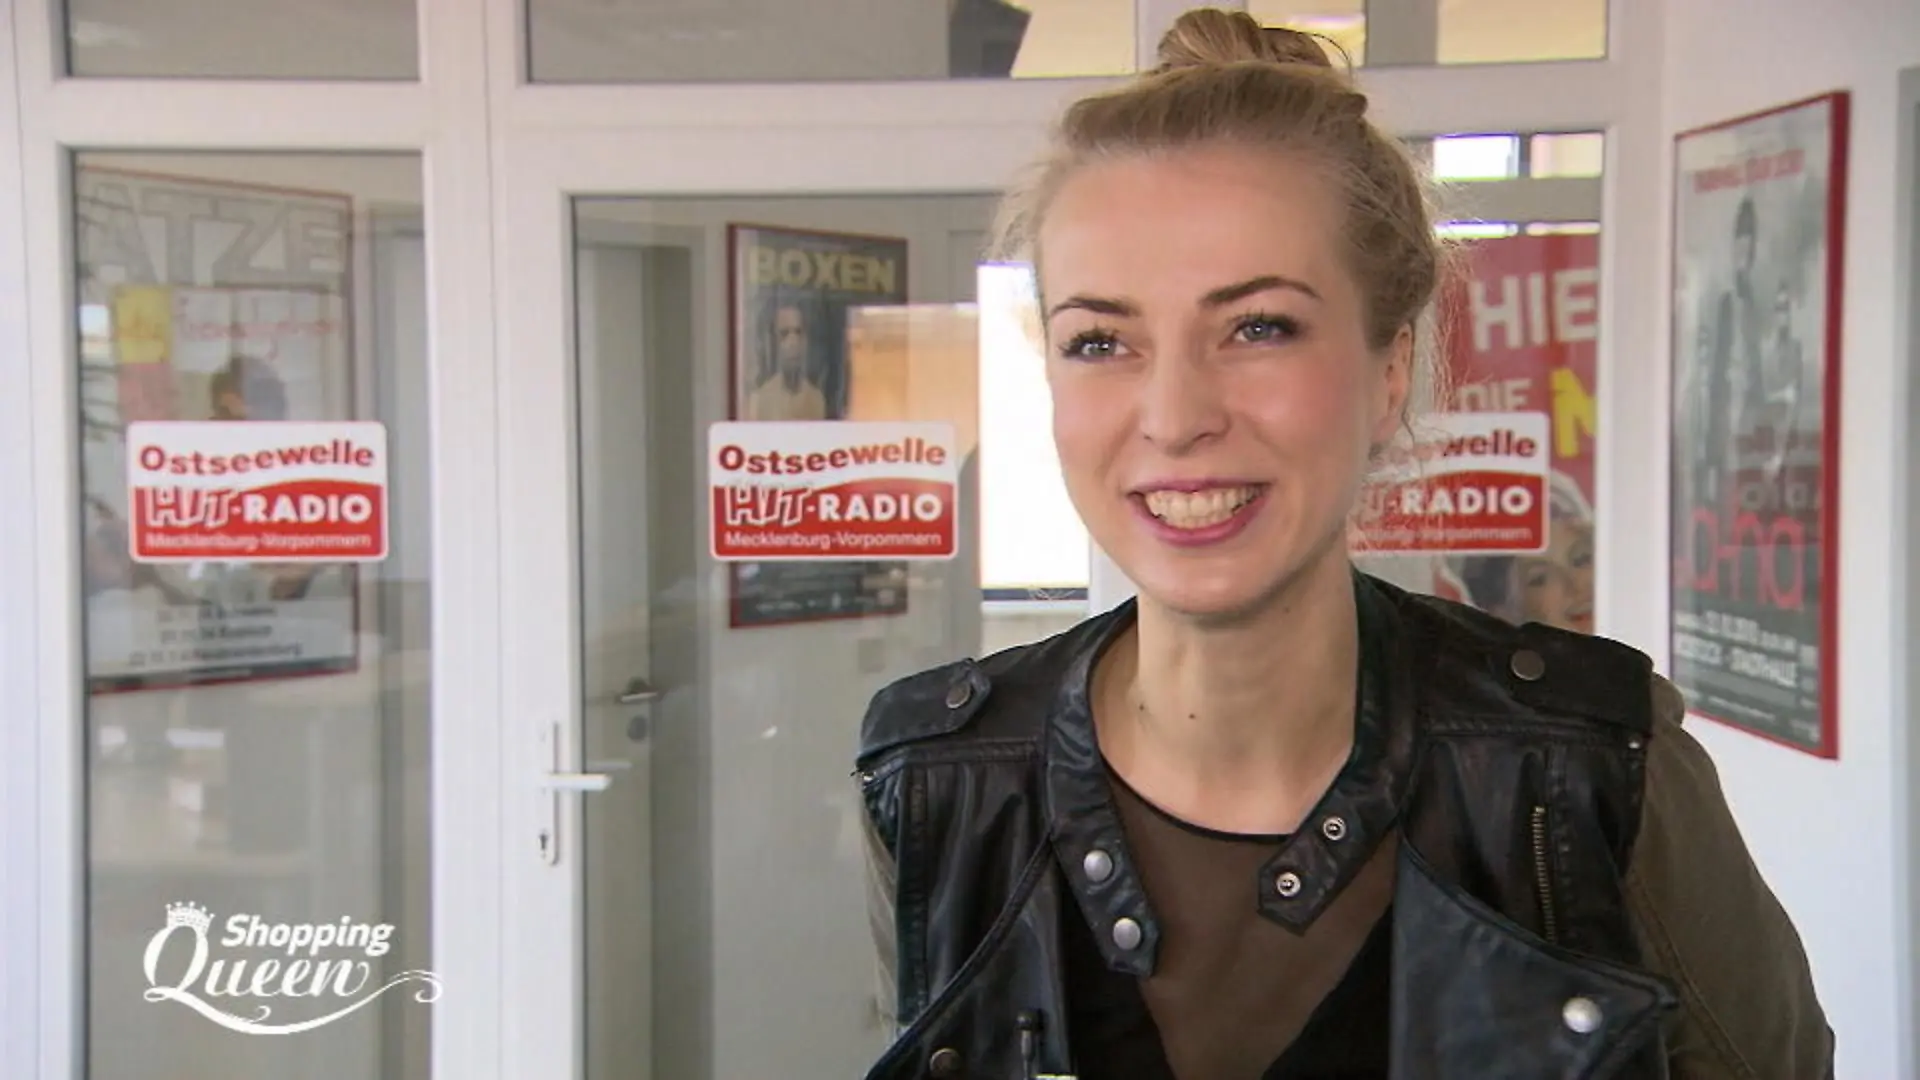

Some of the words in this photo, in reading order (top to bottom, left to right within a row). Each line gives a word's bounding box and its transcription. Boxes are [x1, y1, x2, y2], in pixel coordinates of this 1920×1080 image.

[748, 246, 896, 294] BOXEN
[139, 438, 375, 476] Ostseewelle
[719, 436, 946, 475] Ostseewelle
[145, 486, 374, 529] HIT-RADIO
[725, 485, 943, 527] HIT-RADIO
[145, 531, 373, 552] Mecklenburg-Vorpommern
[725, 530, 943, 551] Mecklenburg-Vorpommern
